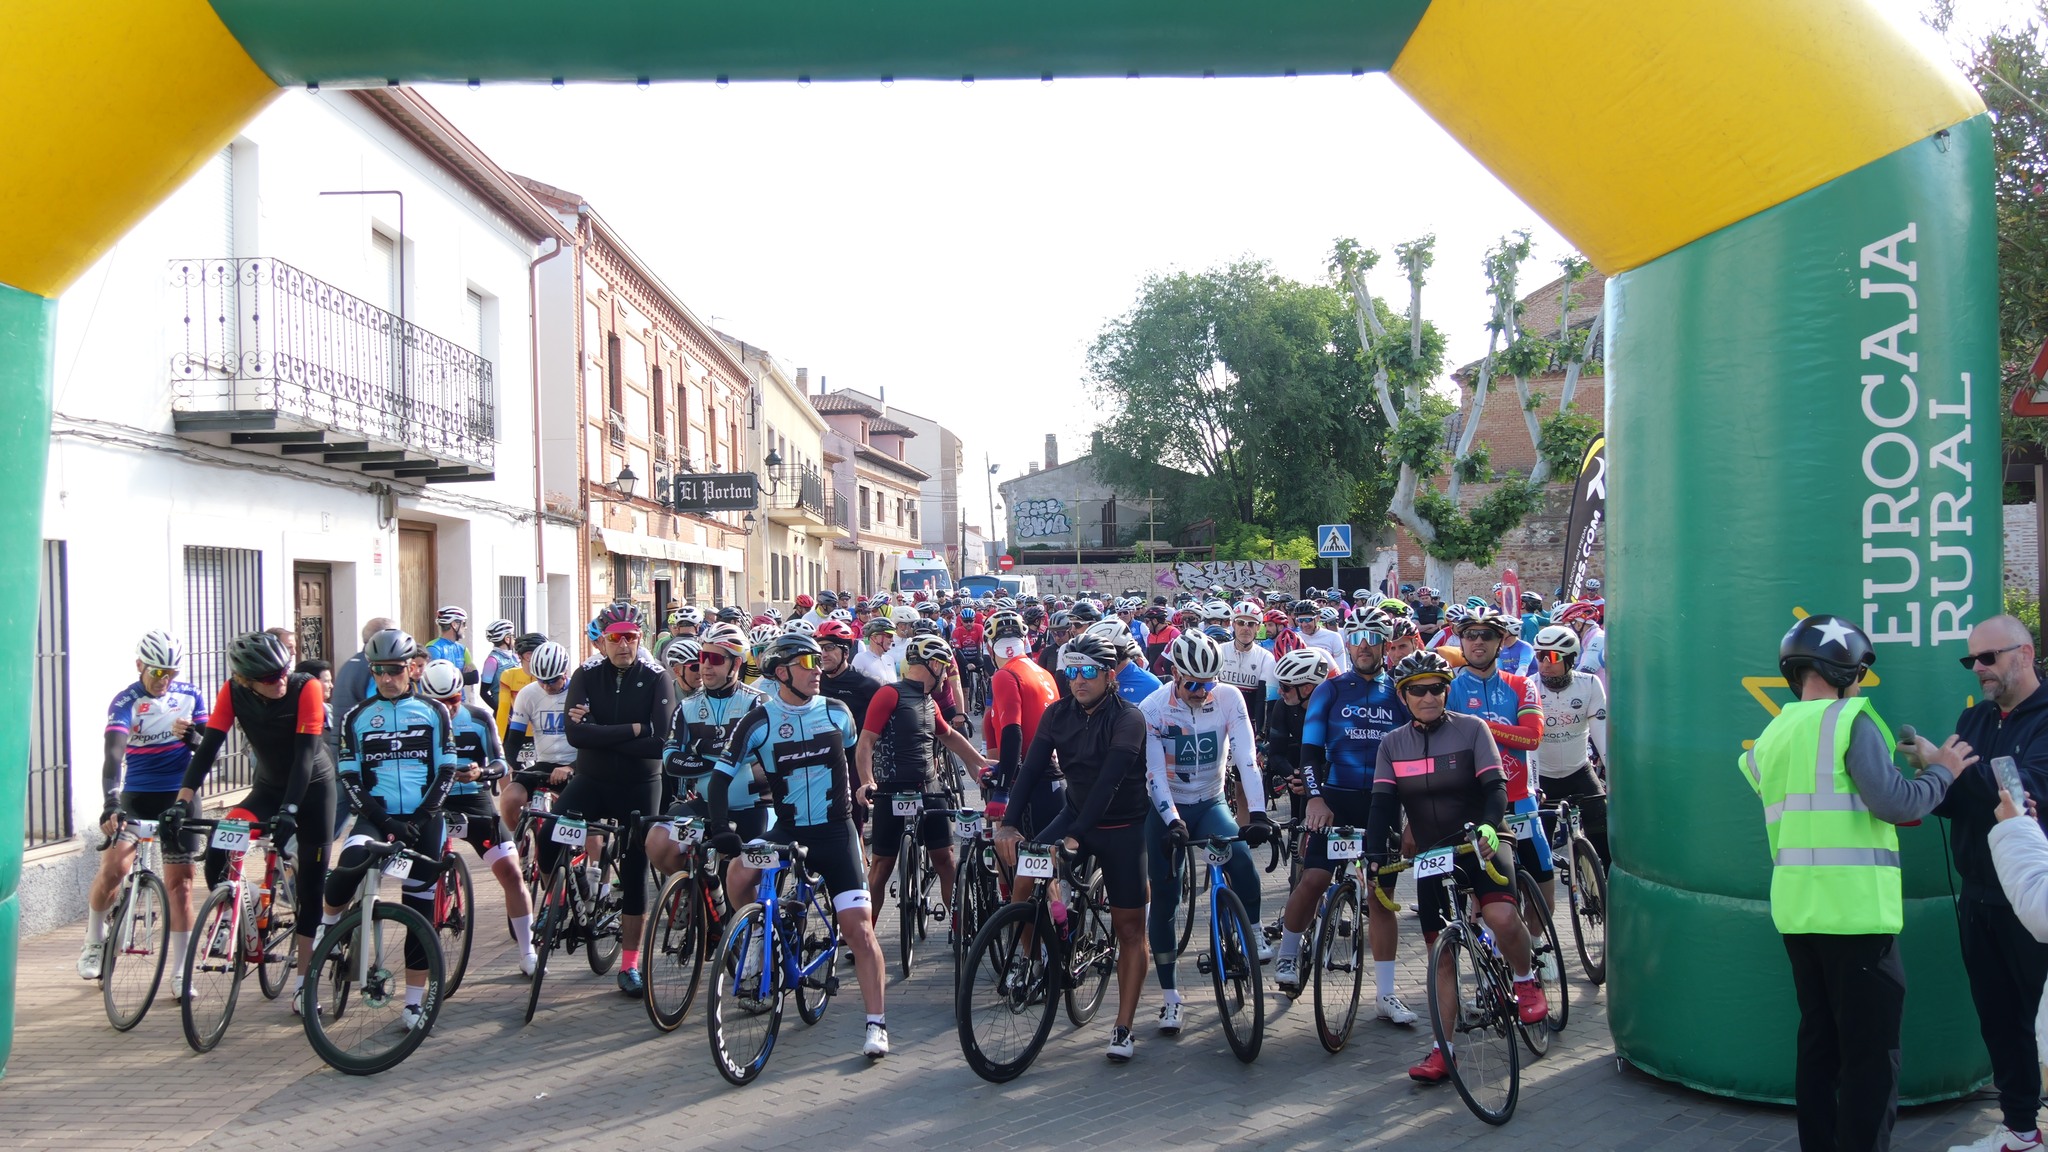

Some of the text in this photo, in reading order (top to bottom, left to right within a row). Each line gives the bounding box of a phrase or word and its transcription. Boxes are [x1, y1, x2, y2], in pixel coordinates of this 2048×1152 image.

[1860, 222, 1920, 648] EUROCAJA
[679, 480, 752, 505] El Porton
[1929, 372, 1974, 647] RURAL
[1222, 670, 1257, 685] STELVIO
[365, 730, 426, 741] FUJI
[1180, 737, 1213, 756] AC
[366, 750, 428, 761] DOMINION
[778, 746, 831, 763] FUJI
[897, 801, 917, 811] 071
[448, 825, 463, 834] 79
[559, 826, 581, 839] 040
[959, 821, 977, 833] 151
[1511, 822, 1525, 834] 67
[220, 831, 244, 844] 207
[1333, 841, 1356, 852] 004
[1025, 858, 1048, 870] 002
[1420, 856, 1446, 871] 082
[425, 981, 438, 1011] SWISS
